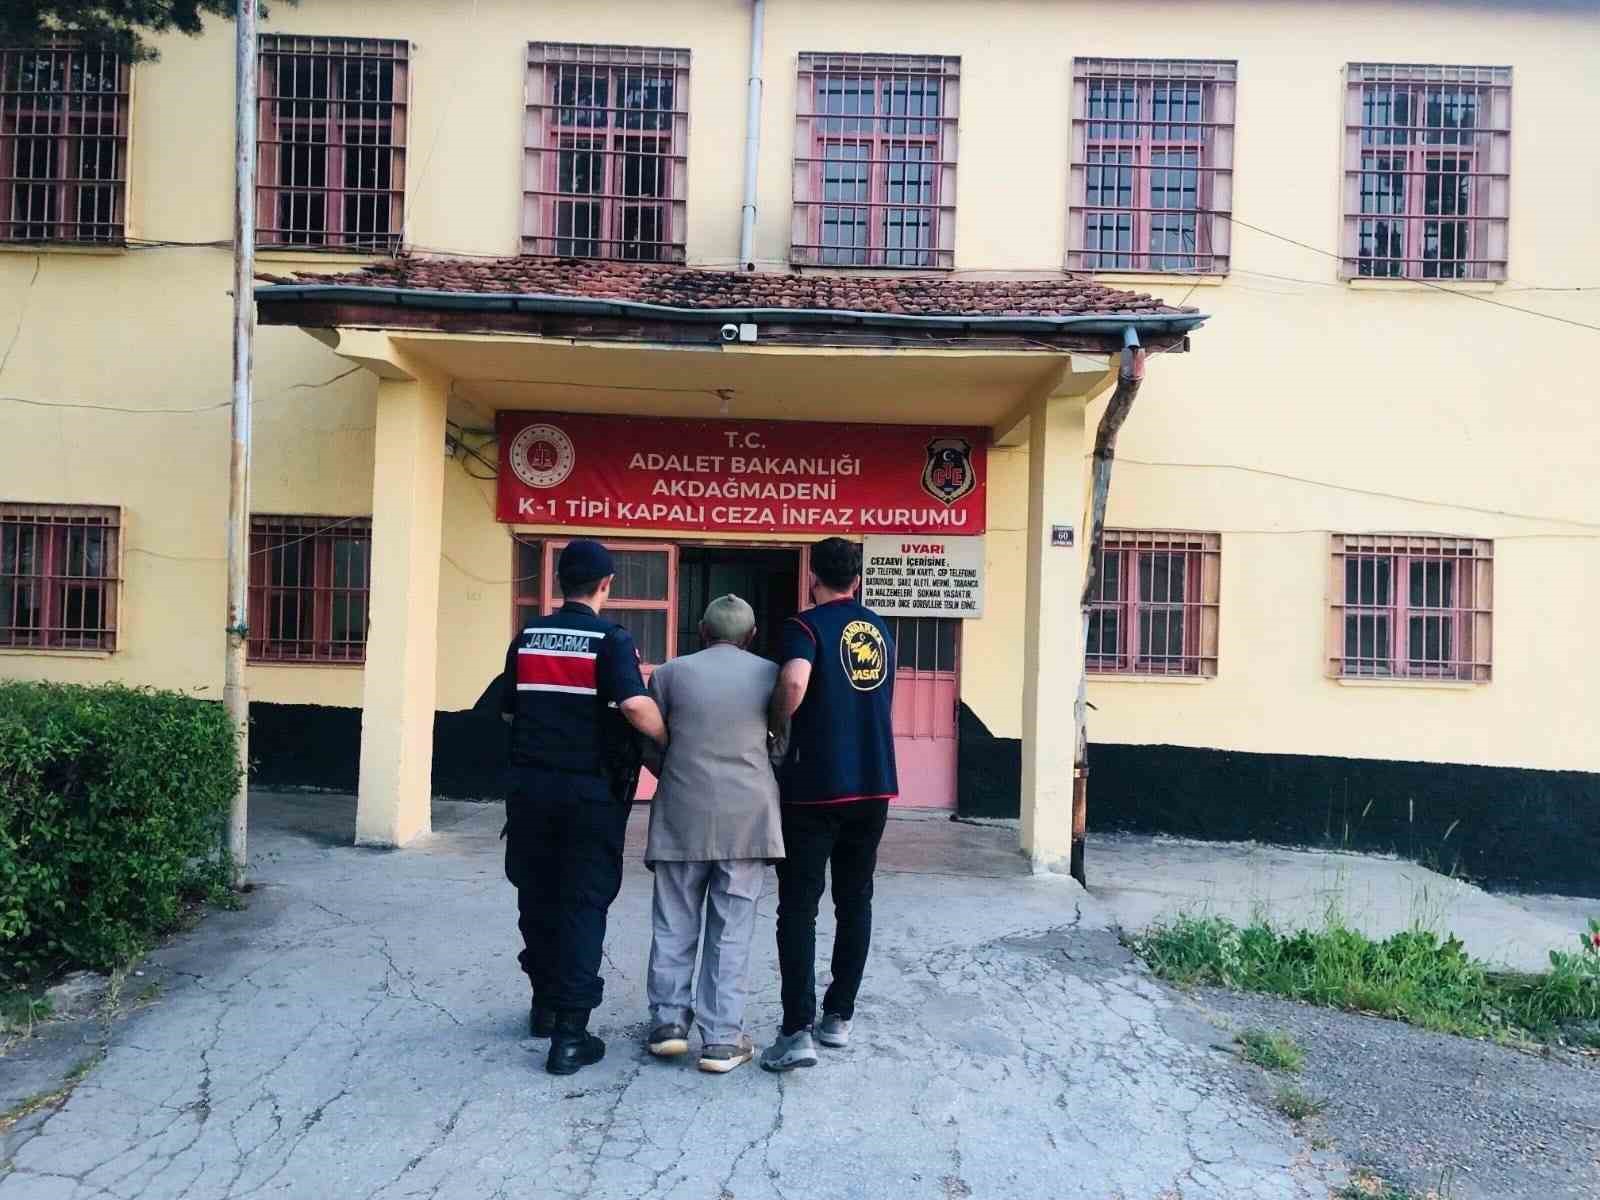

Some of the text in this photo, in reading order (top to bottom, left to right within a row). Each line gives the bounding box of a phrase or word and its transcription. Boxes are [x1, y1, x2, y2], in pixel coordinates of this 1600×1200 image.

[723, 431, 766, 448] T.C.
[628, 453, 860, 476] ADALET BAKANLIĞI
[652, 478, 836, 500] AKDAĞMADENİ
[518, 496, 967, 526] K-1 TİPİ KAPALI CEZA İNFAZ KURUMU
[901, 544, 945, 554] UYARI
[870, 555, 902, 566] CEZAEVİ
[526, 634, 591, 653] JANDARMA
